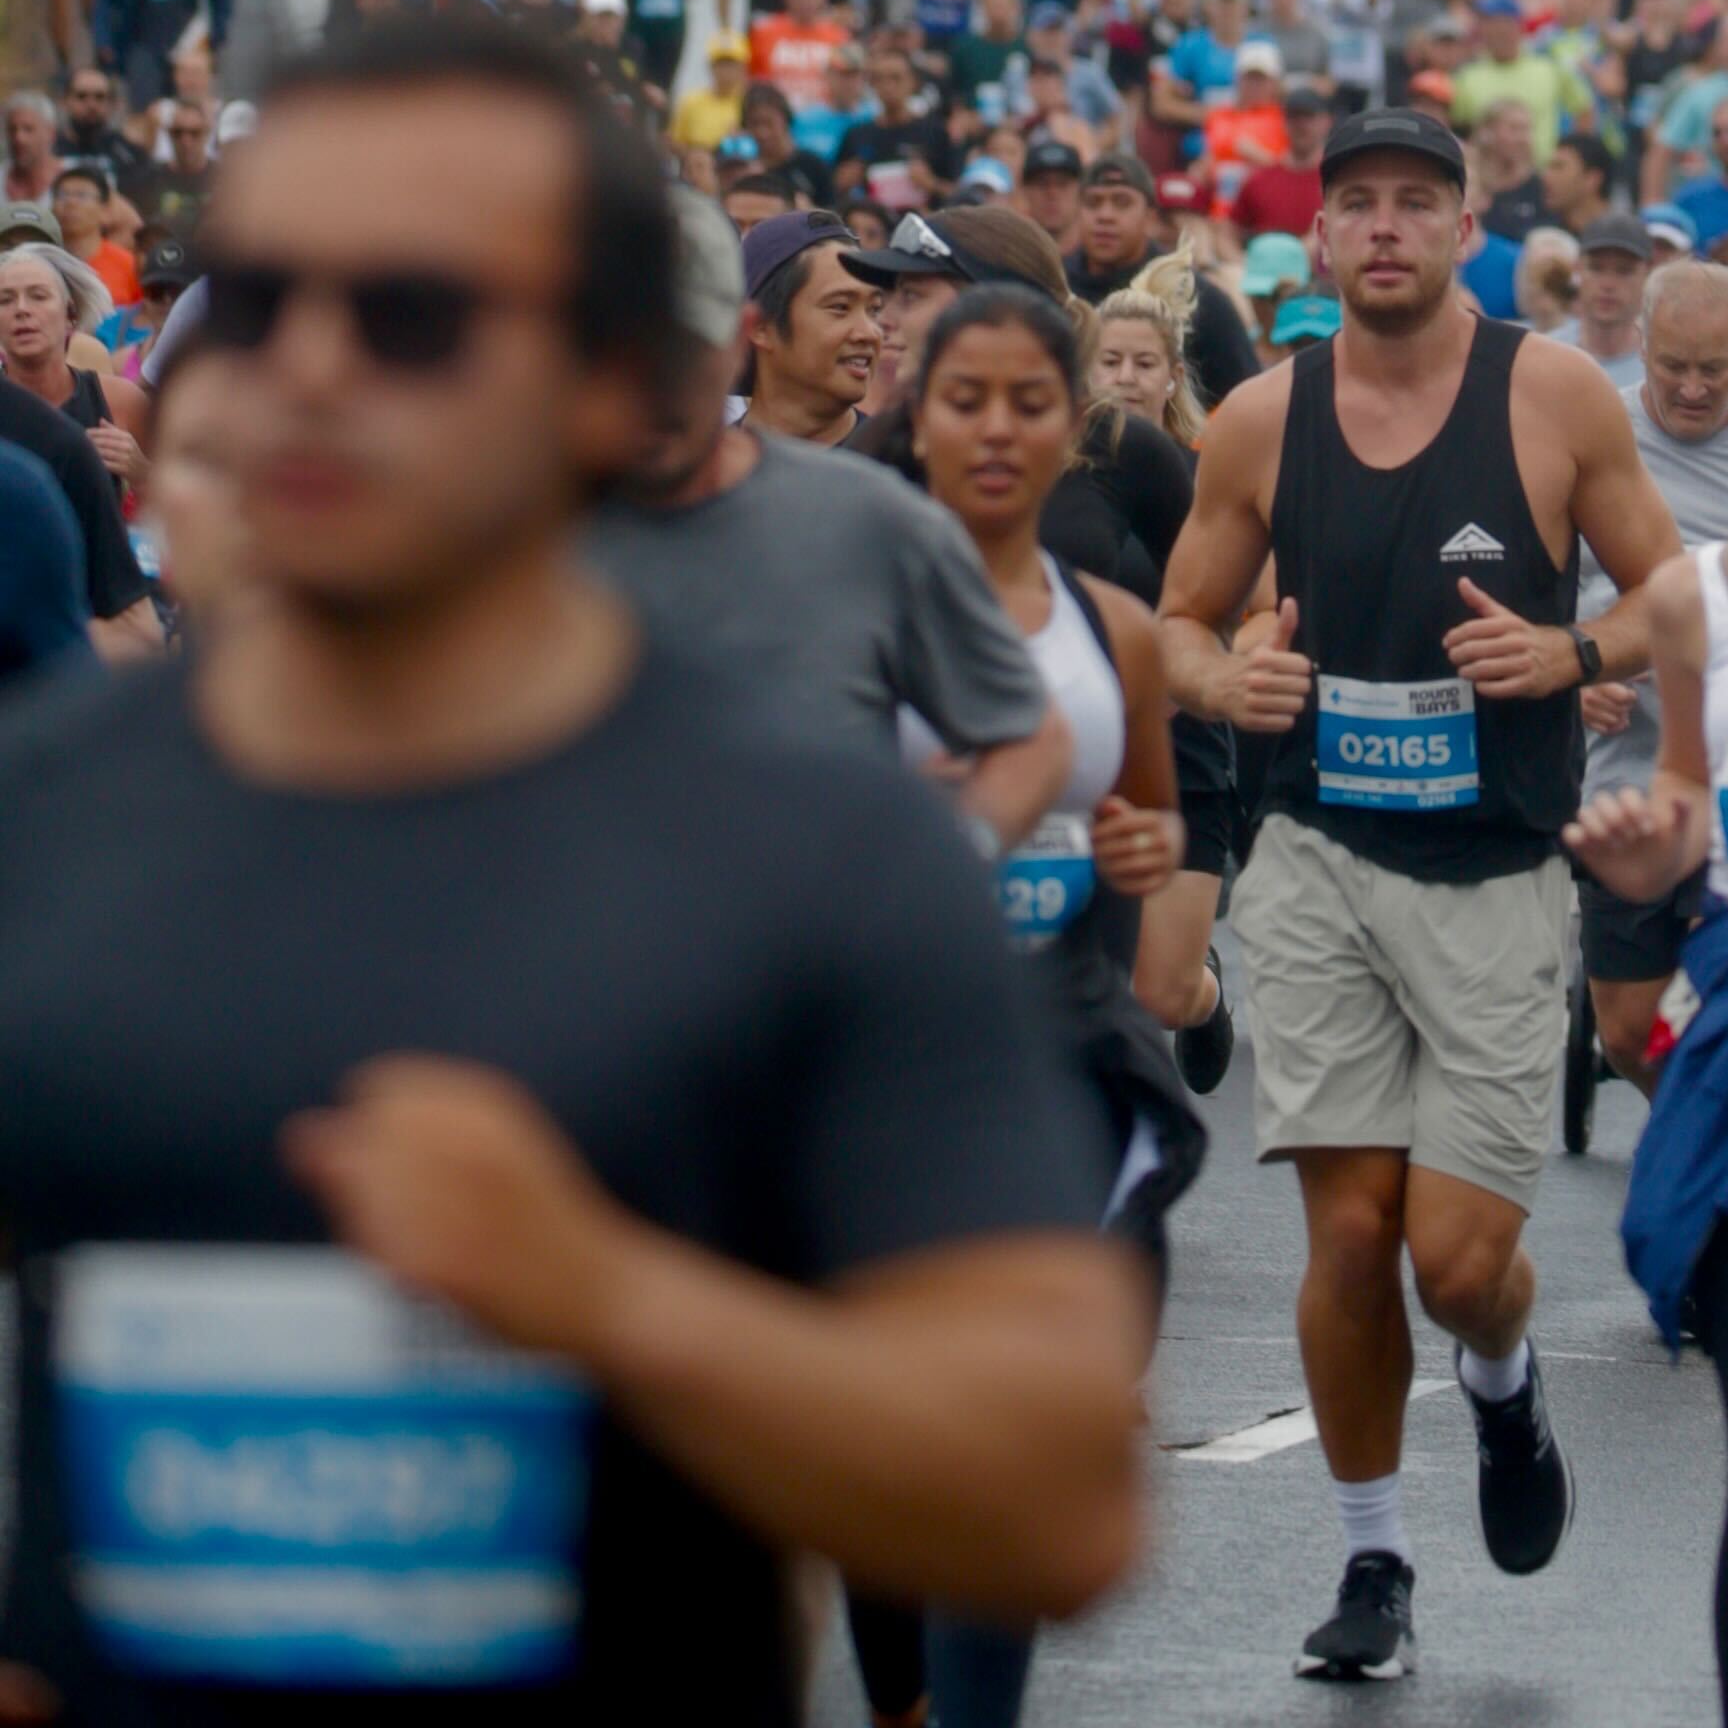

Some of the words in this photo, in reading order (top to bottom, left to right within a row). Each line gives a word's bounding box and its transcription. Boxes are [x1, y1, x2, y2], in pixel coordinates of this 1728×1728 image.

[1408, 686, 1460, 702] ROUND
[1415, 700, 1461, 715] BAYS
[1338, 732, 1451, 768] 02165
